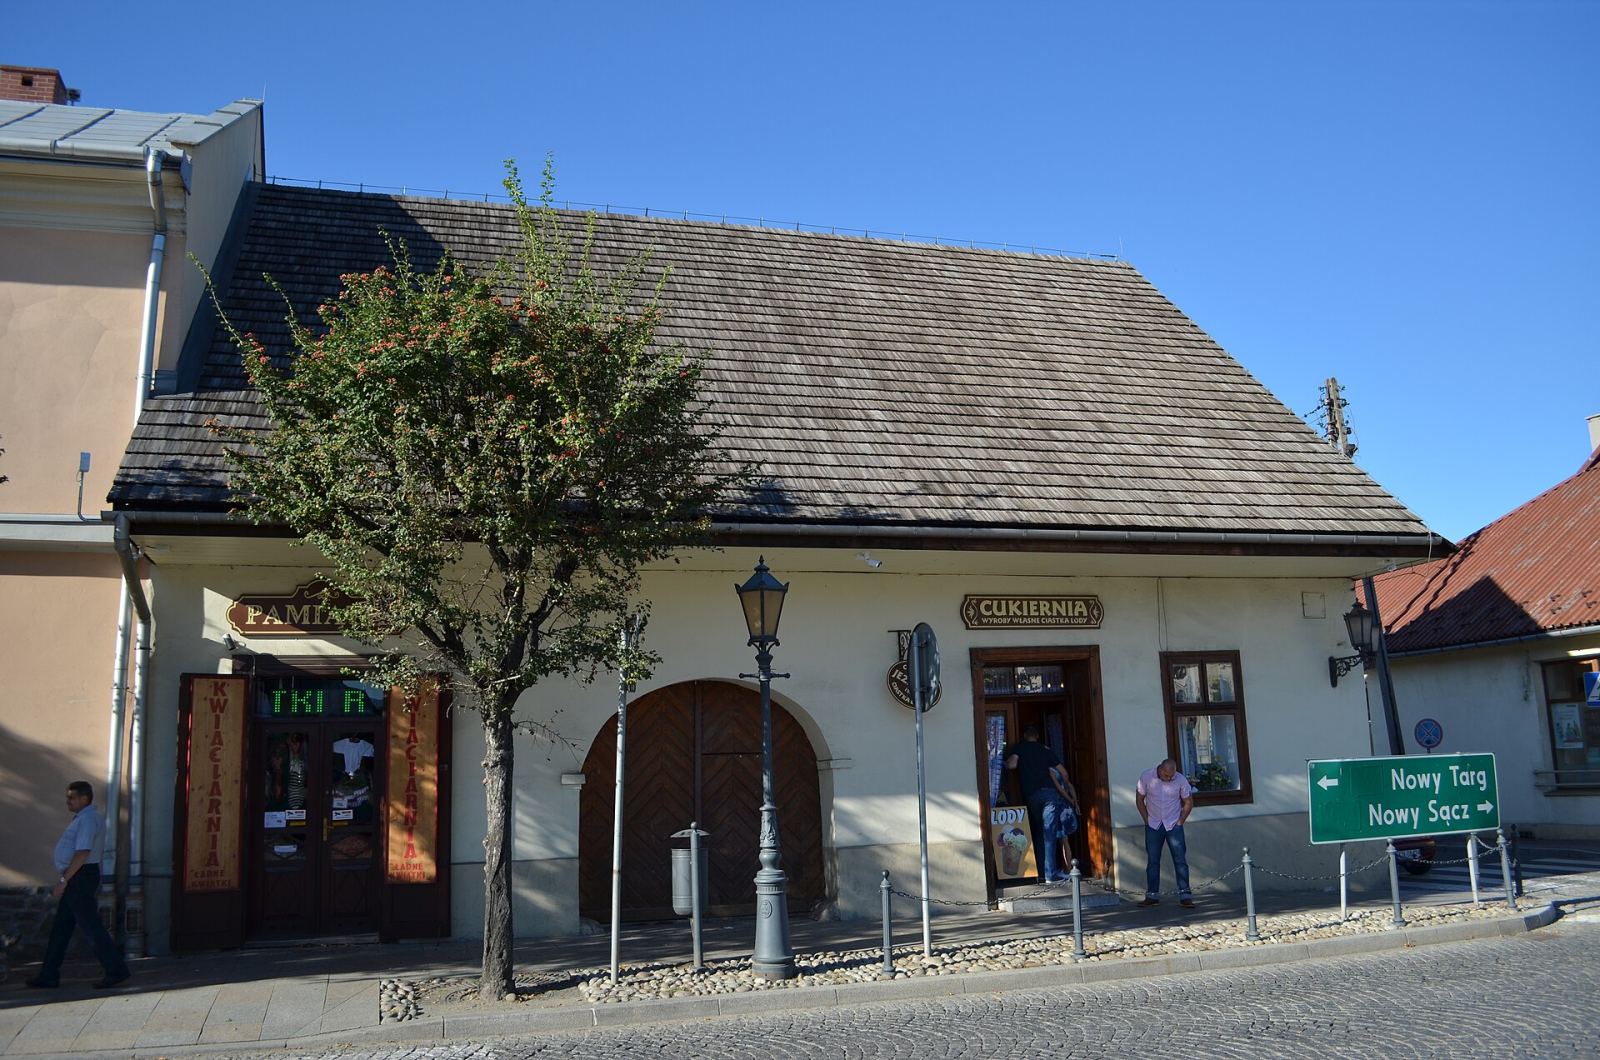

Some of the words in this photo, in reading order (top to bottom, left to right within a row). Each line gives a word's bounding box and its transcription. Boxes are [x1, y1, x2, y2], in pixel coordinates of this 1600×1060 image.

[245, 604, 352, 625] PAMI
[979, 599, 1088, 617] CUKIERNIA
[981, 617, 1010, 625] WYROBY
[1041, 617, 1070, 625] CIASTKA
[1071, 617, 1088, 625] LODY
[272, 690, 323, 713] TKI
[344, 690, 364, 713] R
[207, 681, 229, 867] KWIACIARNIA
[405, 696, 422, 859] WIACIARNIA
[1391, 768, 1441, 794] Nowy
[1449, 765, 1487, 791] Targ
[991, 808, 1026, 825] LODY
[1368, 803, 1420, 829] Nowy
[1428, 800, 1470, 826] Sącz
